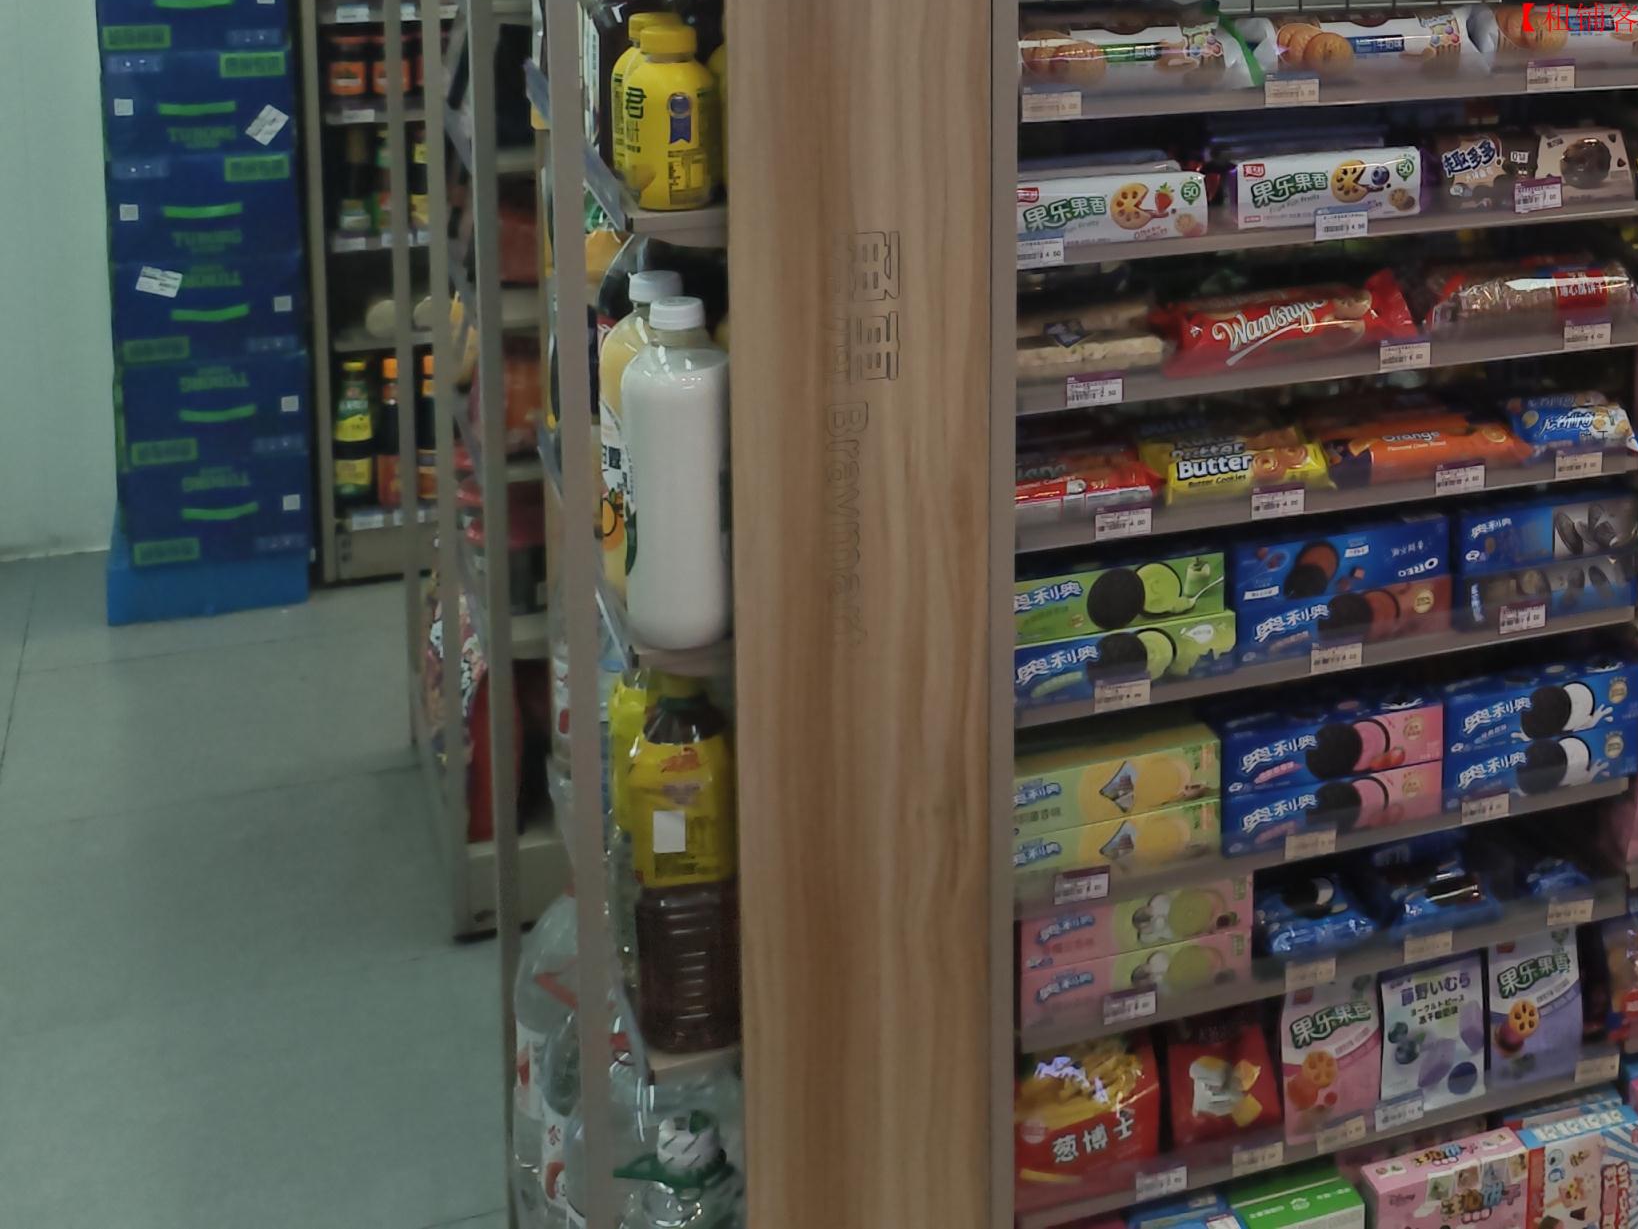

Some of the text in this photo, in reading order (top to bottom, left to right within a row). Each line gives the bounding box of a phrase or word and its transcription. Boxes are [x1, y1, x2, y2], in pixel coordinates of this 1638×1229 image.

[1397, 162, 1413, 174] 50
[1183, 185, 1198, 197] 50
[1252, 172, 1328, 207] 果乐果香
[1023, 195, 1107, 232] 果乐果香
[1382, 429, 1441, 443] Orange
[1178, 454, 1254, 481] Butter
[1397, 557, 1439, 577] OREO
[1253, 604, 1330, 643] 奥利奥
[1016, 645, 1099, 686] 奥利奥
[1463, 697, 1532, 734] 奥利奥
[1242, 734, 1318, 773] 奥利奥
[1457, 750, 1527, 789] 奥利奥
[1241, 794, 1318, 833] 奥利奥
[1498, 953, 1571, 998] 果乐果香
[1053, 1112, 1136, 1163] 葱博士
